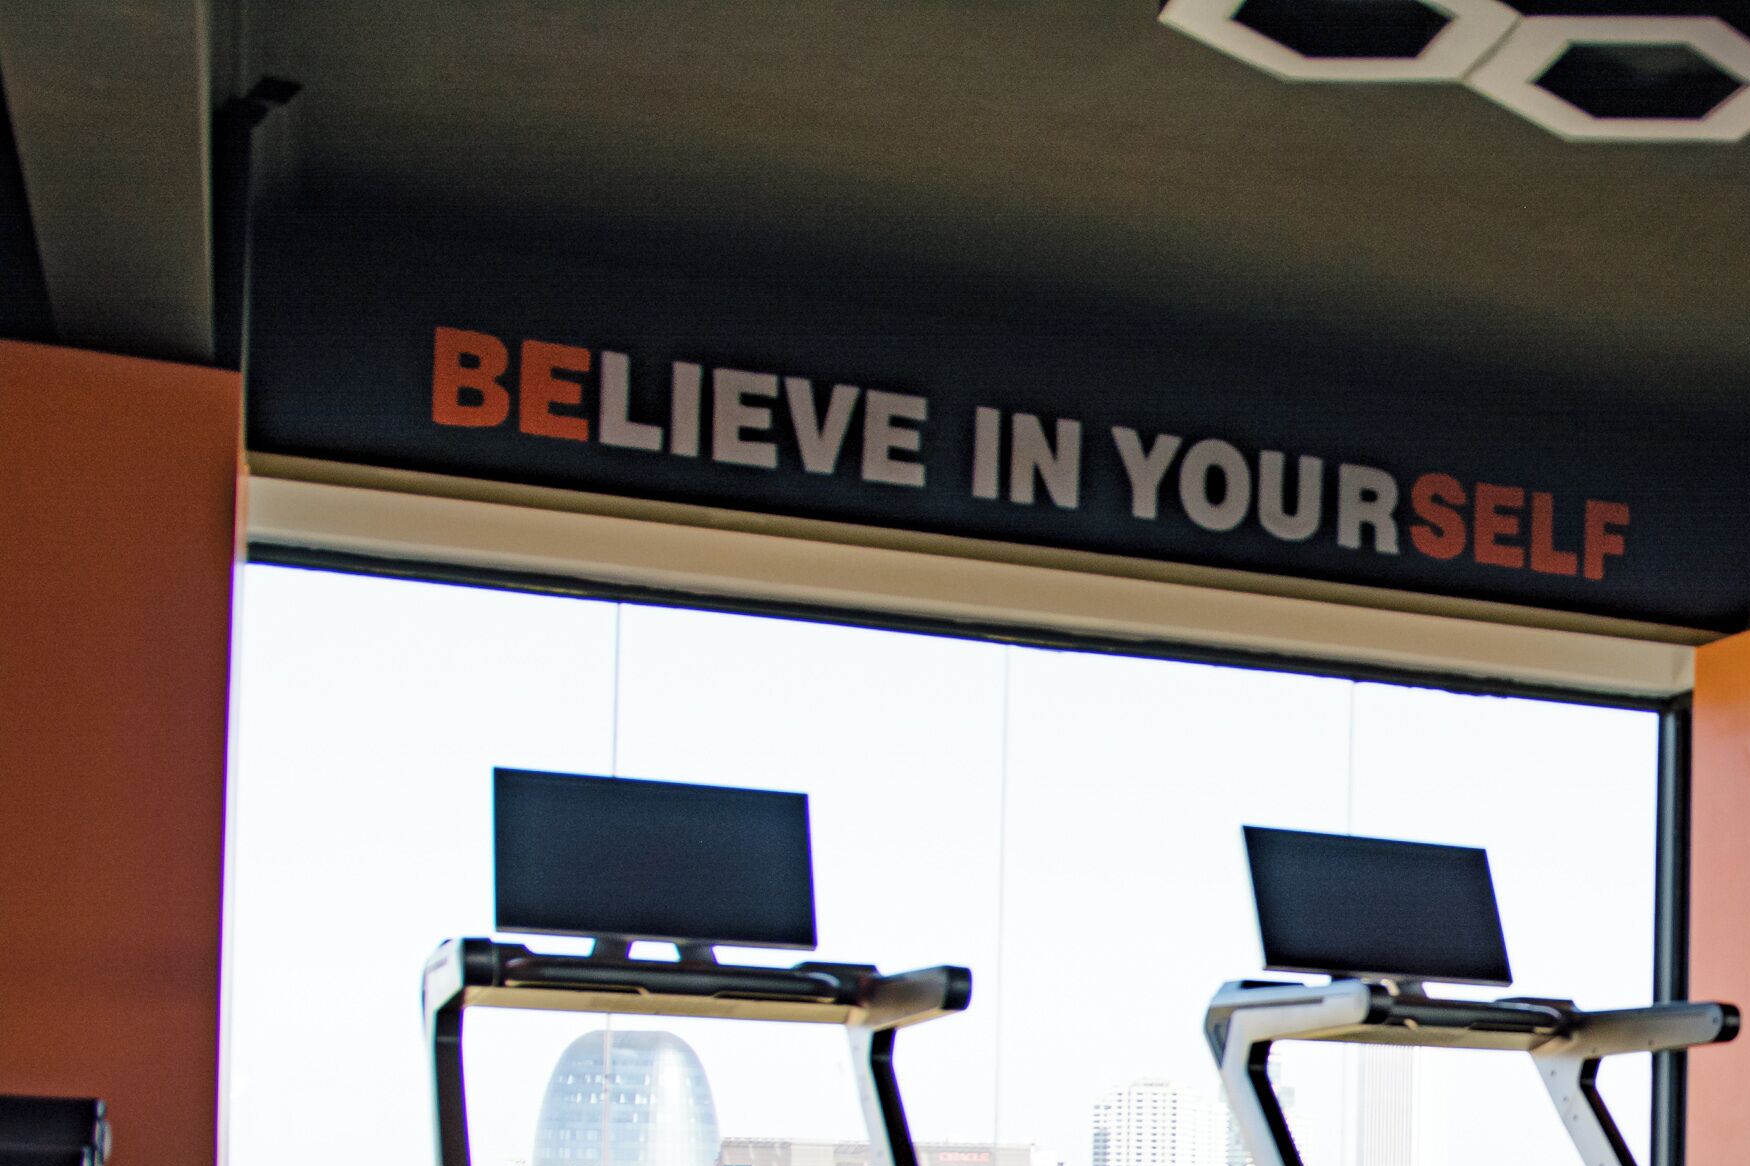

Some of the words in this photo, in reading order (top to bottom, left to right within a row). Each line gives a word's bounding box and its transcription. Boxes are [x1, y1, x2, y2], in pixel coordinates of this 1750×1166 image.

[432, 326, 928, 489] BELIEVE
[972, 406, 1082, 508] IN
[1111, 426, 1630, 580] YOURSELF
